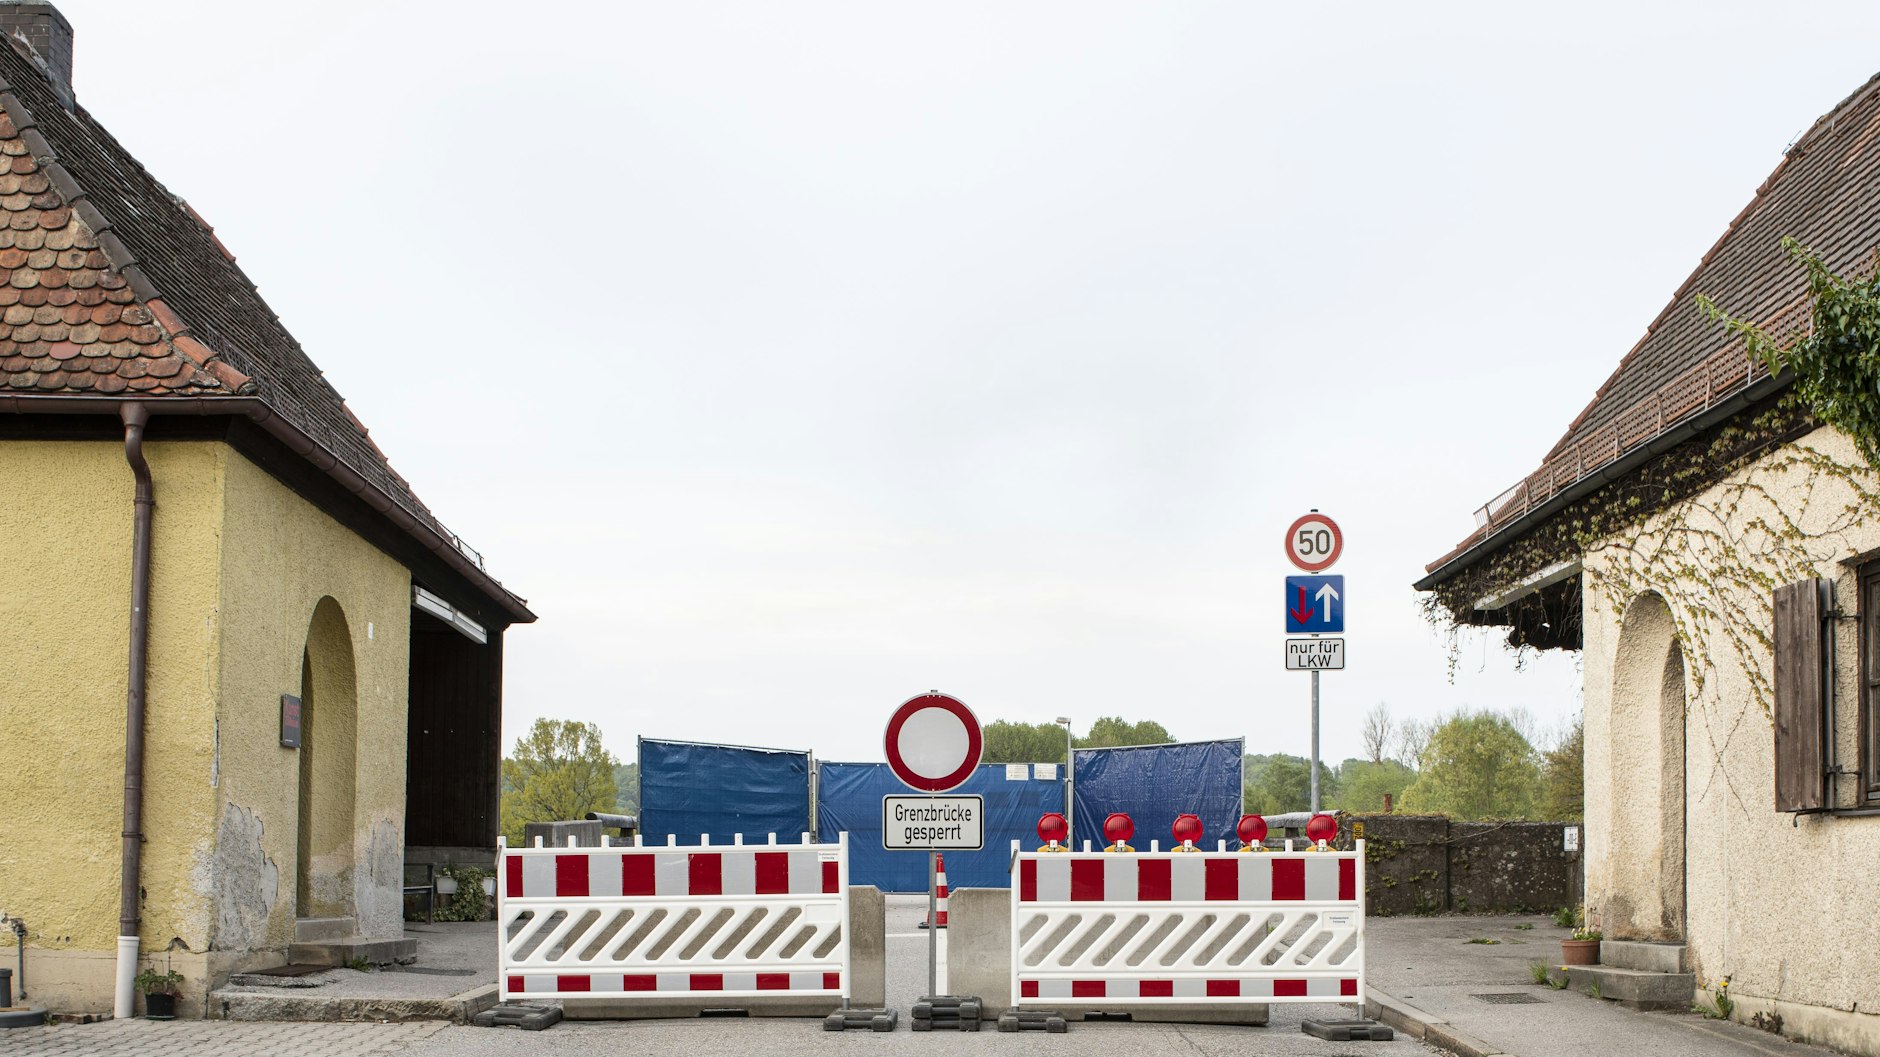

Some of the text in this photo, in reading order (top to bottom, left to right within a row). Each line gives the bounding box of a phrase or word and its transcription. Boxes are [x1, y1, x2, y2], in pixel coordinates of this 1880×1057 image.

[1299, 529, 1331, 556] 50
[1290, 640, 1340, 654] nur für
[1298, 654, 1332, 668] LKW
[895, 803, 972, 822] Grenzbrücke
[904, 823, 961, 845] gesperrt
